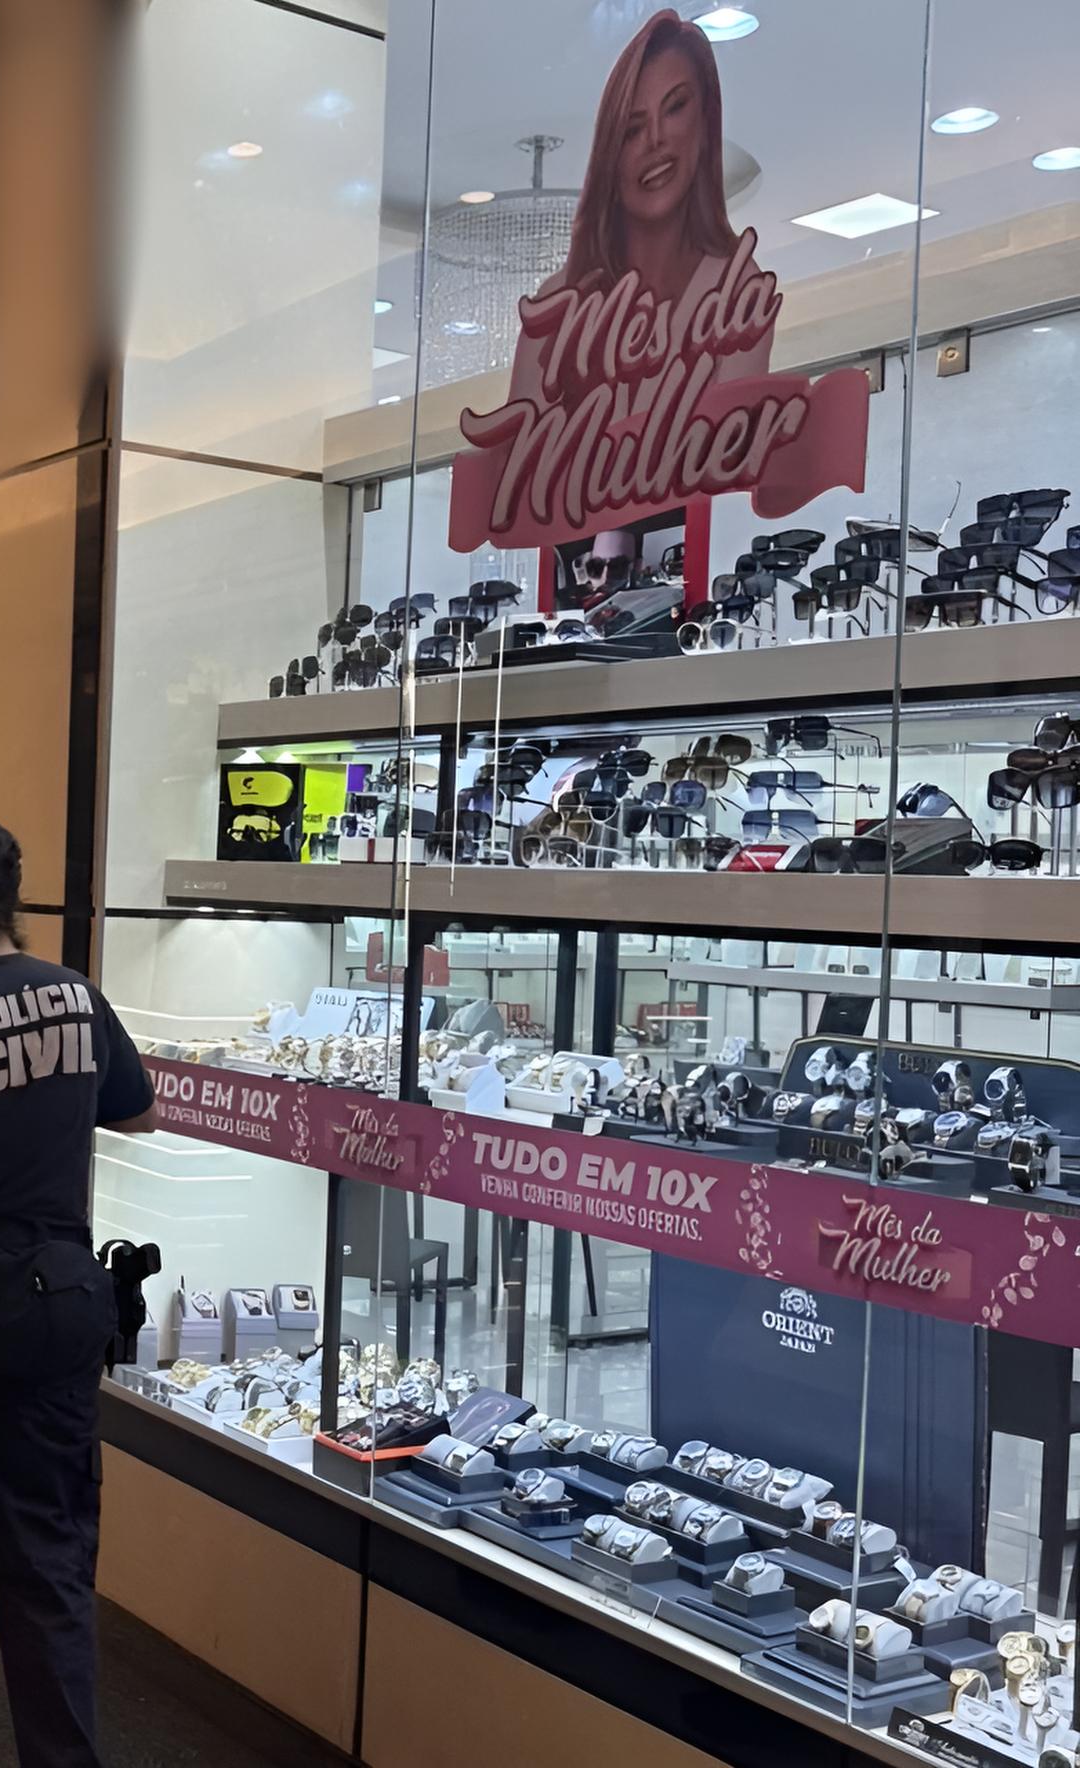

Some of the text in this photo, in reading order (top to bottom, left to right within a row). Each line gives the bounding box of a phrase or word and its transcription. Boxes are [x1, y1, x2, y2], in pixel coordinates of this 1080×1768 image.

[520, 227, 783, 392] Mês da
[460, 351, 810, 533] Mulher
[148, 1069, 281, 1121] UDO EM 10X
[472, 1132, 719, 1213] TUDO EM 10X
[818, 1220, 951, 1292] Mulher
[842, 1194, 943, 1246] Mês da
[762, 1310, 835, 1345] ORIENT
